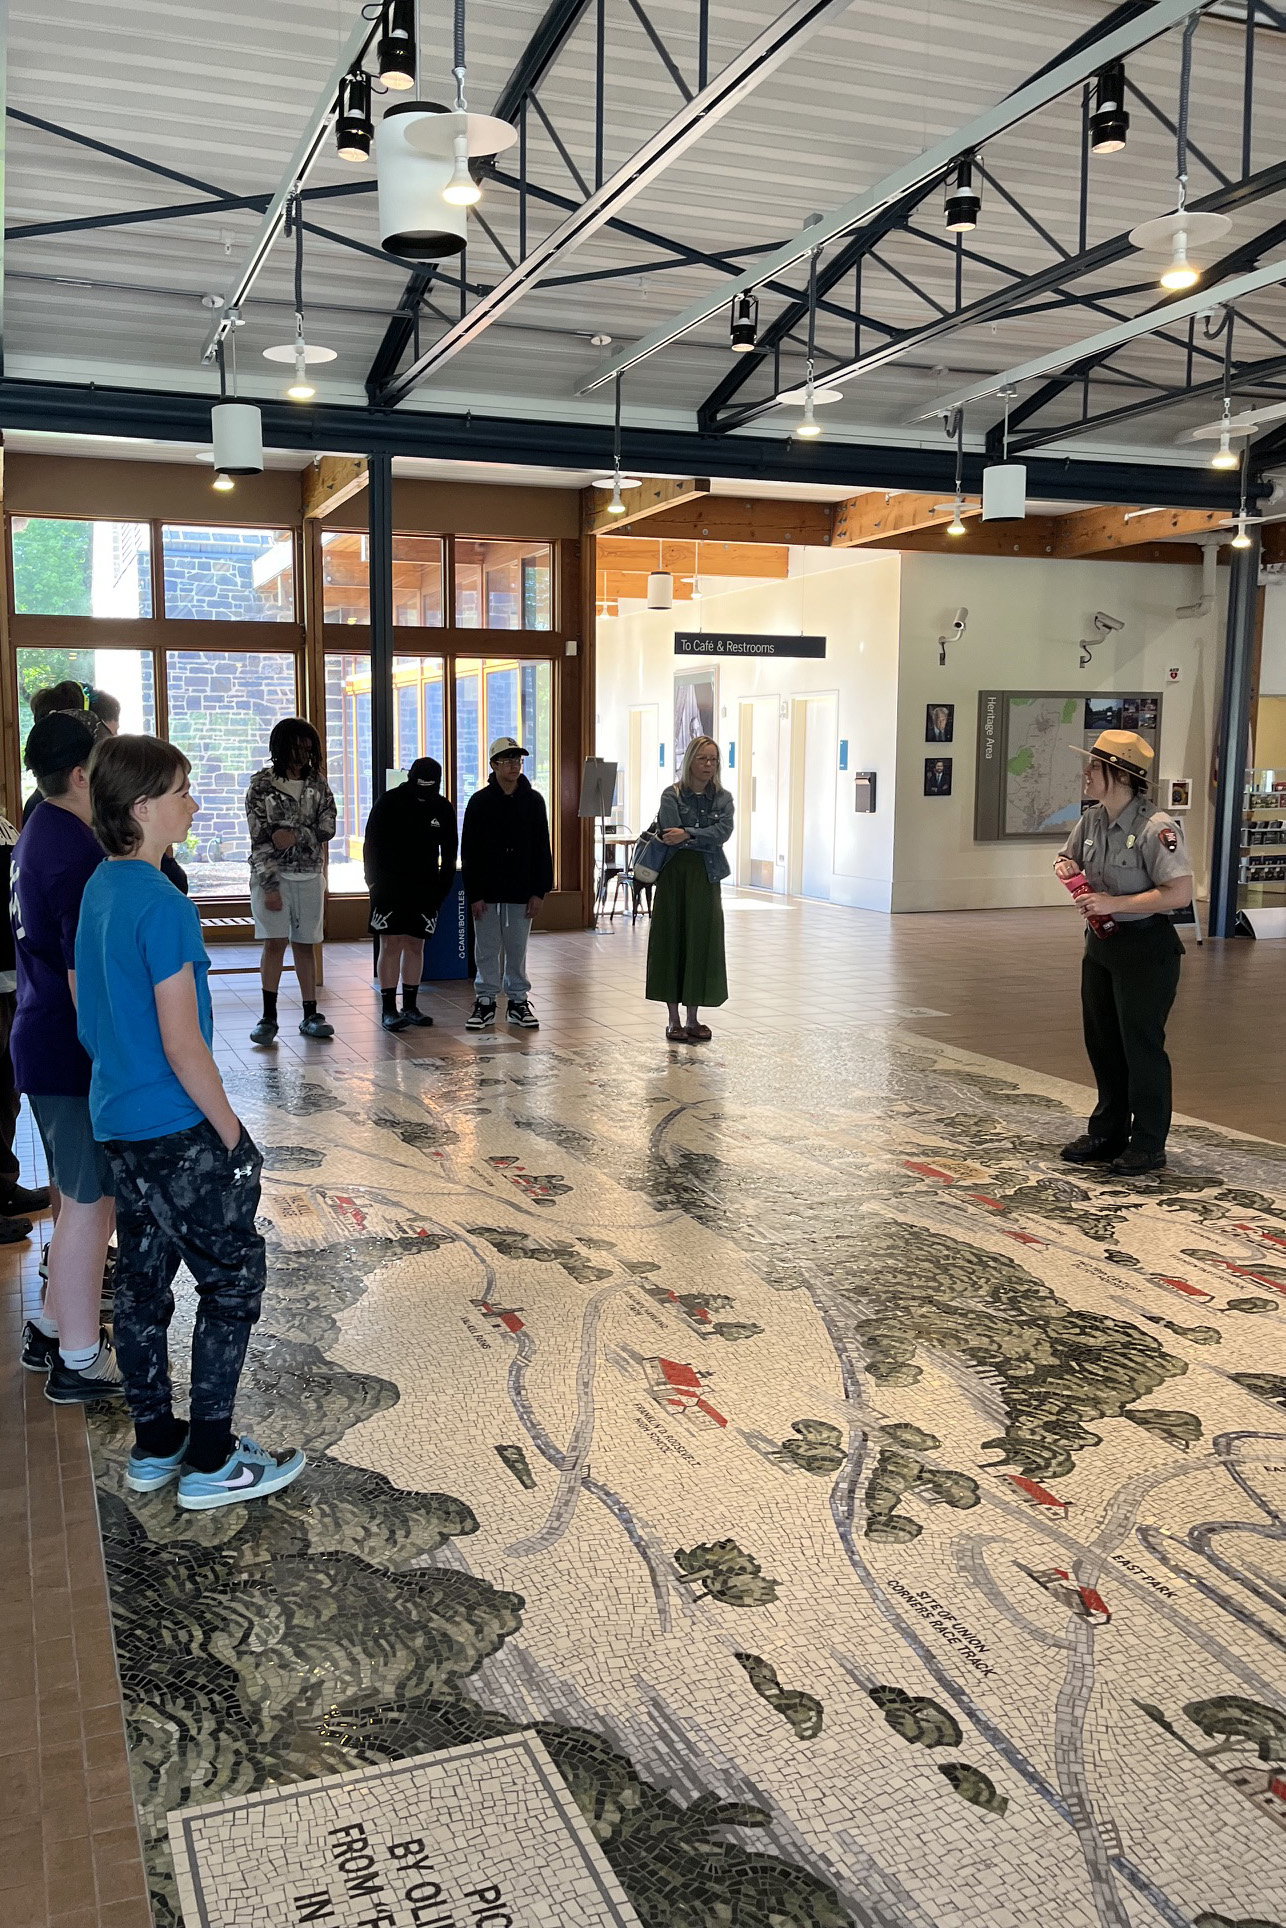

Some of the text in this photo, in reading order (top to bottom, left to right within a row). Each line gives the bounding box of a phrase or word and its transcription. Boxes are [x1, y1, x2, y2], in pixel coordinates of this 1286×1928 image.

[681, 639, 775, 654] To Café & Restrooms
[985, 696, 997, 759] Heritage Area
[458, 890, 466, 951] CANS/BOTTLES
[632, 1403, 662, 1429] FRANKLIN
[662, 1434, 702, 1469] ROOSEVELT
[647, 1431, 673, 1454] SCHOOL
[1111, 1554, 1179, 1598] EAST PARK
[887, 1579, 999, 1677] CORNERS RACE TRACK
[916, 1590, 991, 1653] SITE OF UNION
[328, 1822, 384, 1900] FROM
[387, 1838, 434, 1872] BY
[293, 1890, 335, 1924] IN
